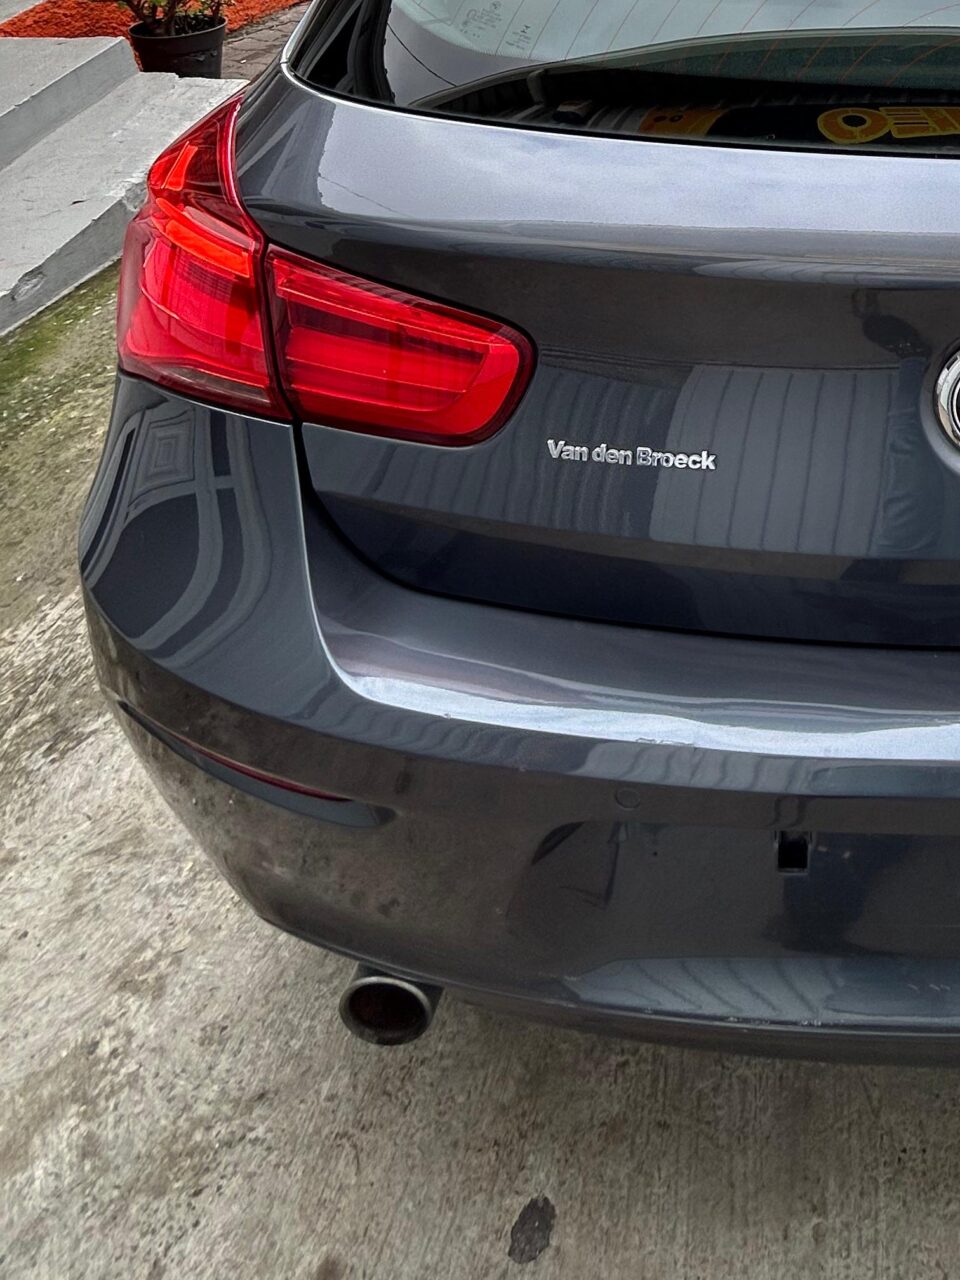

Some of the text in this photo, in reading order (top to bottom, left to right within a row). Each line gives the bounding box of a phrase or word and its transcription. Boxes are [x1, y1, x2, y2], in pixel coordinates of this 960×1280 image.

[546, 438, 717, 470] Van den Broeck
